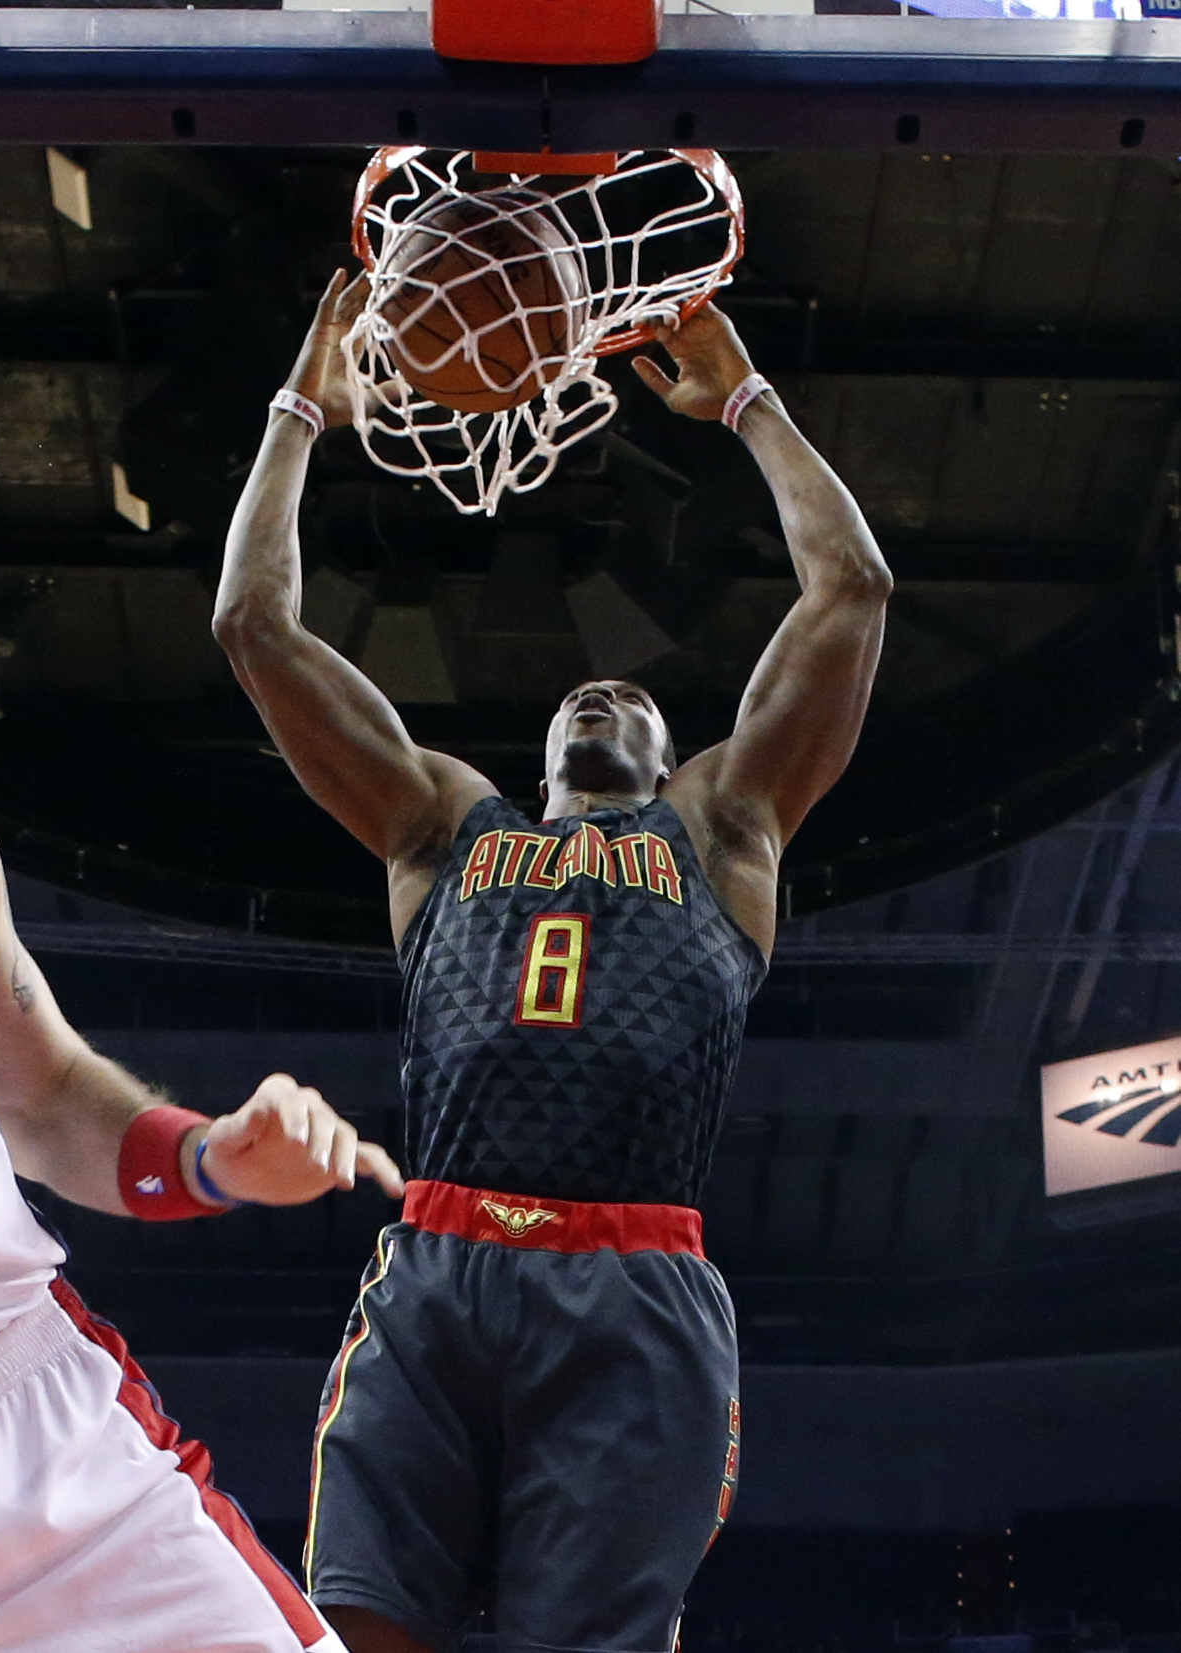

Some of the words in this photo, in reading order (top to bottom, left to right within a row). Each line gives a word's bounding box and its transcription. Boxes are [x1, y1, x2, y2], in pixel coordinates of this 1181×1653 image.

[460, 822, 683, 906] ATLANTA
[513, 911, 592, 1029] 8
[1091, 1059, 1181, 1090] AMT
